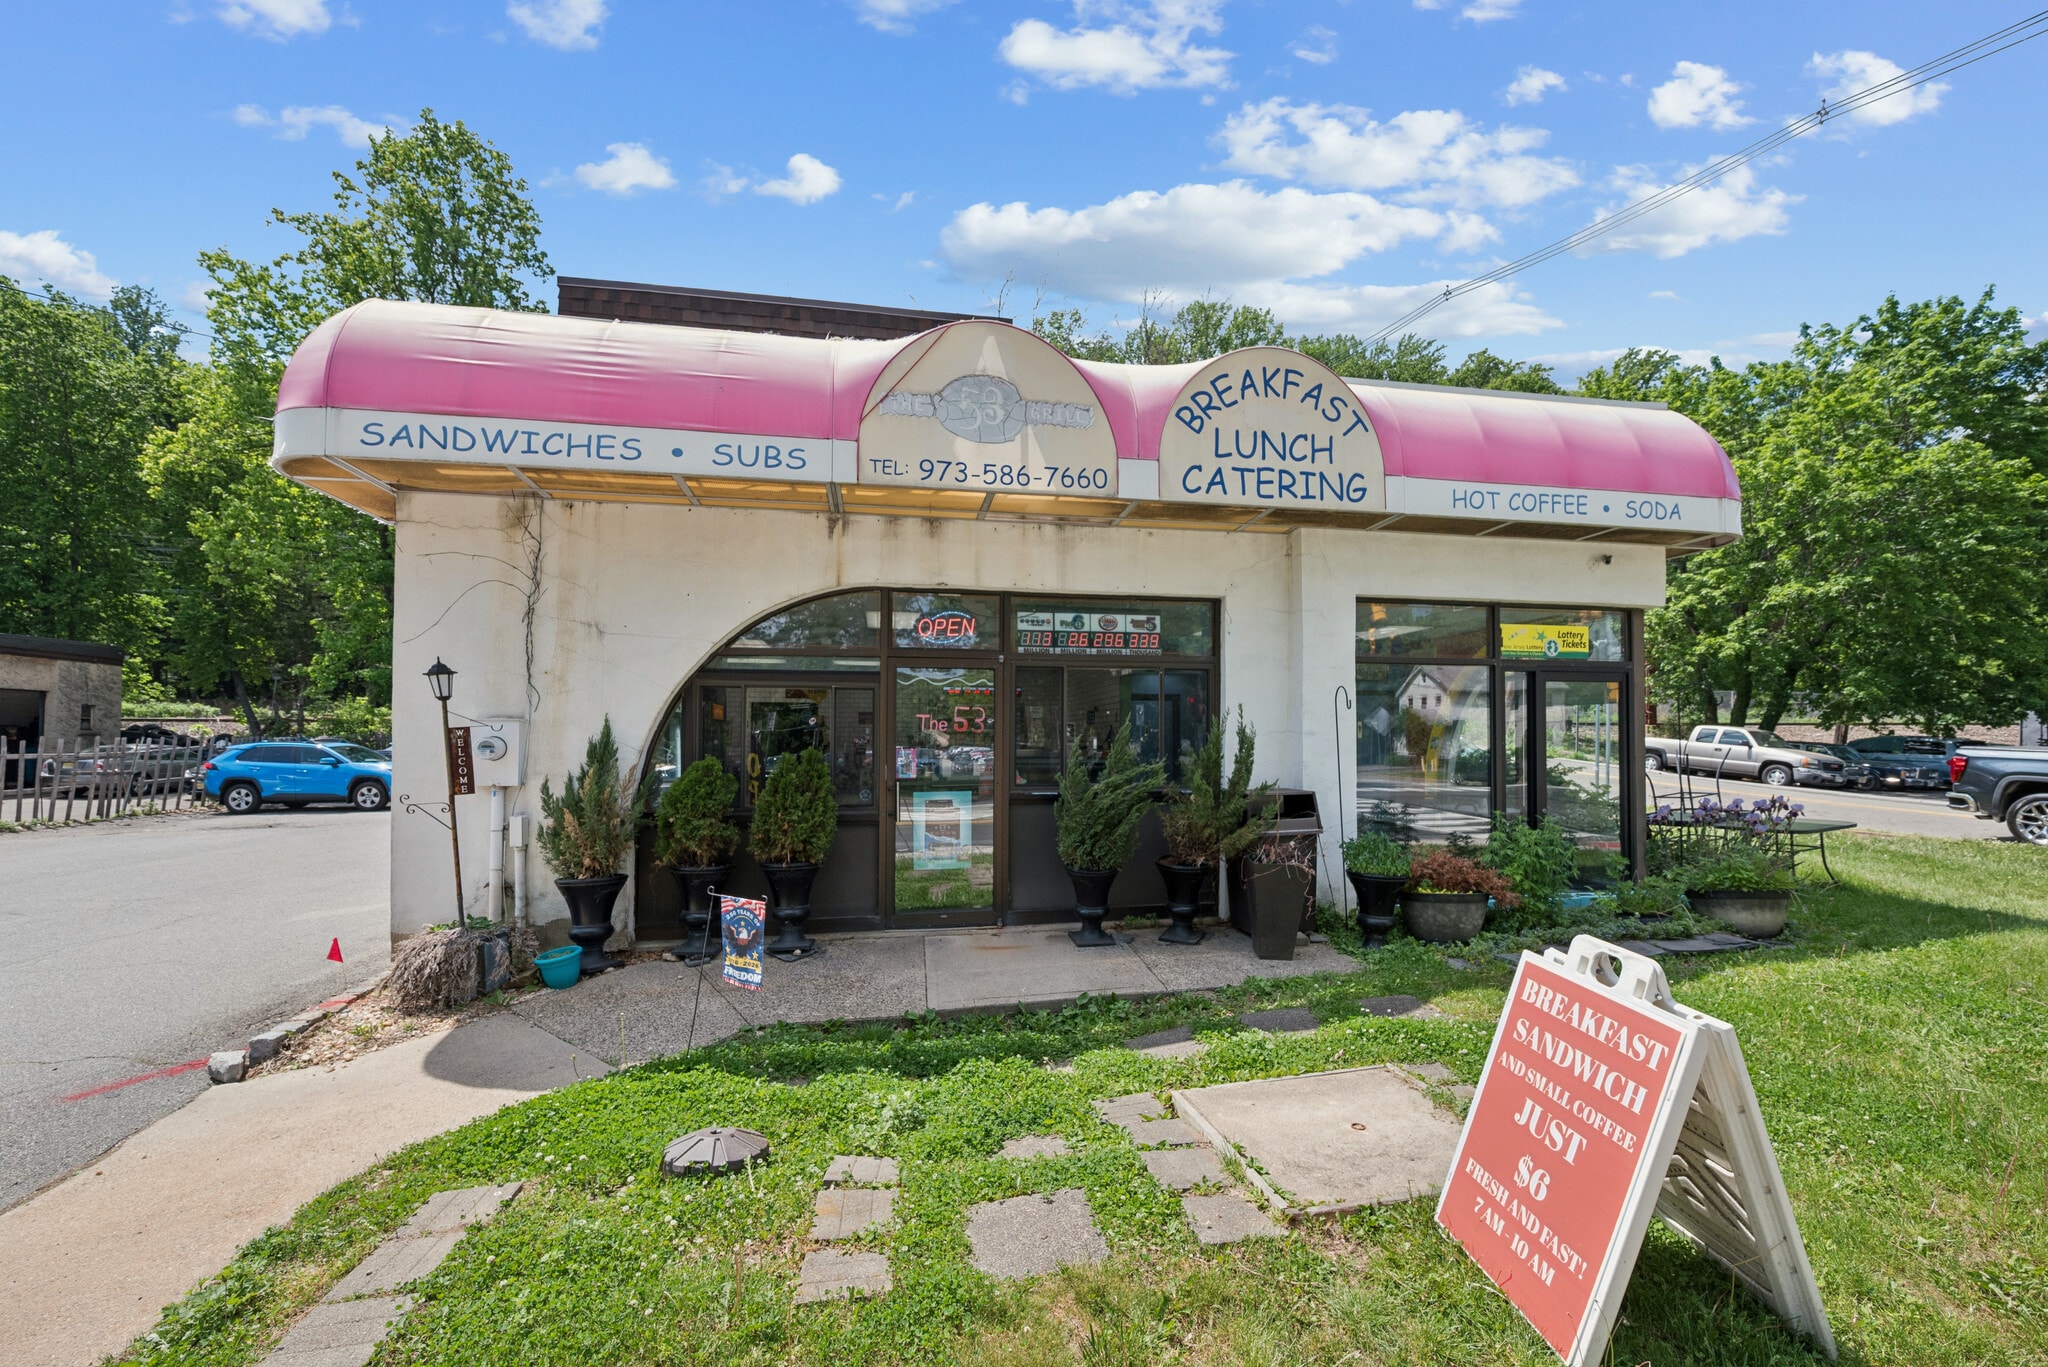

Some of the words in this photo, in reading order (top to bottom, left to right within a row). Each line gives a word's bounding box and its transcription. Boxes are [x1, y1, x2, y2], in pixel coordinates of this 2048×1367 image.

[954, 386, 1005, 430] 53
[1030, 404, 1089, 423] GRILL
[1175, 366, 1369, 437] BREAKFAST
[360, 422, 643, 461] SANDWICHES
[712, 443, 808, 470] SUBS
[1214, 427, 1334, 464] LUNCH
[869, 458, 909, 476] TEL:
[919, 458, 1109, 489] 973-586-7660
[1181, 464, 1368, 503] CATERING
[1452, 488, 1501, 510] HOT
[1508, 492, 1588, 516] COFFEE
[1625, 500, 1682, 521] SODA
[917, 617, 976, 638] OPEN
[1557, 630, 1584, 640] Lottery
[1561, 639, 1587, 649] Tickets
[1023, 646, 1050, 654] MILLION
[916, 713, 948, 732] The
[953, 706, 986, 734] 53
[455, 729, 468, 794] WELCOME
[737, 909, 754, 920] YEARS
[724, 965, 762, 984] FREEDOM
[742, 960, 760, 969] 2026
[1520, 978, 1669, 1072] BREAKFAST
[1513, 1018, 1648, 1116] SANDWICH
[1497, 1051, 1527, 1077] AND
[1525, 1068, 1571, 1110] SMALL
[1572, 1100, 1637, 1153] COFFEE
[1513, 1097, 1588, 1166] JUST
[1513, 1154, 1551, 1202] $6
[1465, 1157, 1510, 1207] FRESH
[1507, 1198, 1541, 1235] AND
[1538, 1225, 1588, 1280] FAST!
[1473, 1196, 1485, 1213] 7
[1480, 1207, 1506, 1237] AM
[1509, 1232, 1529, 1260] 10
[1527, 1254, 1556, 1287] AM
